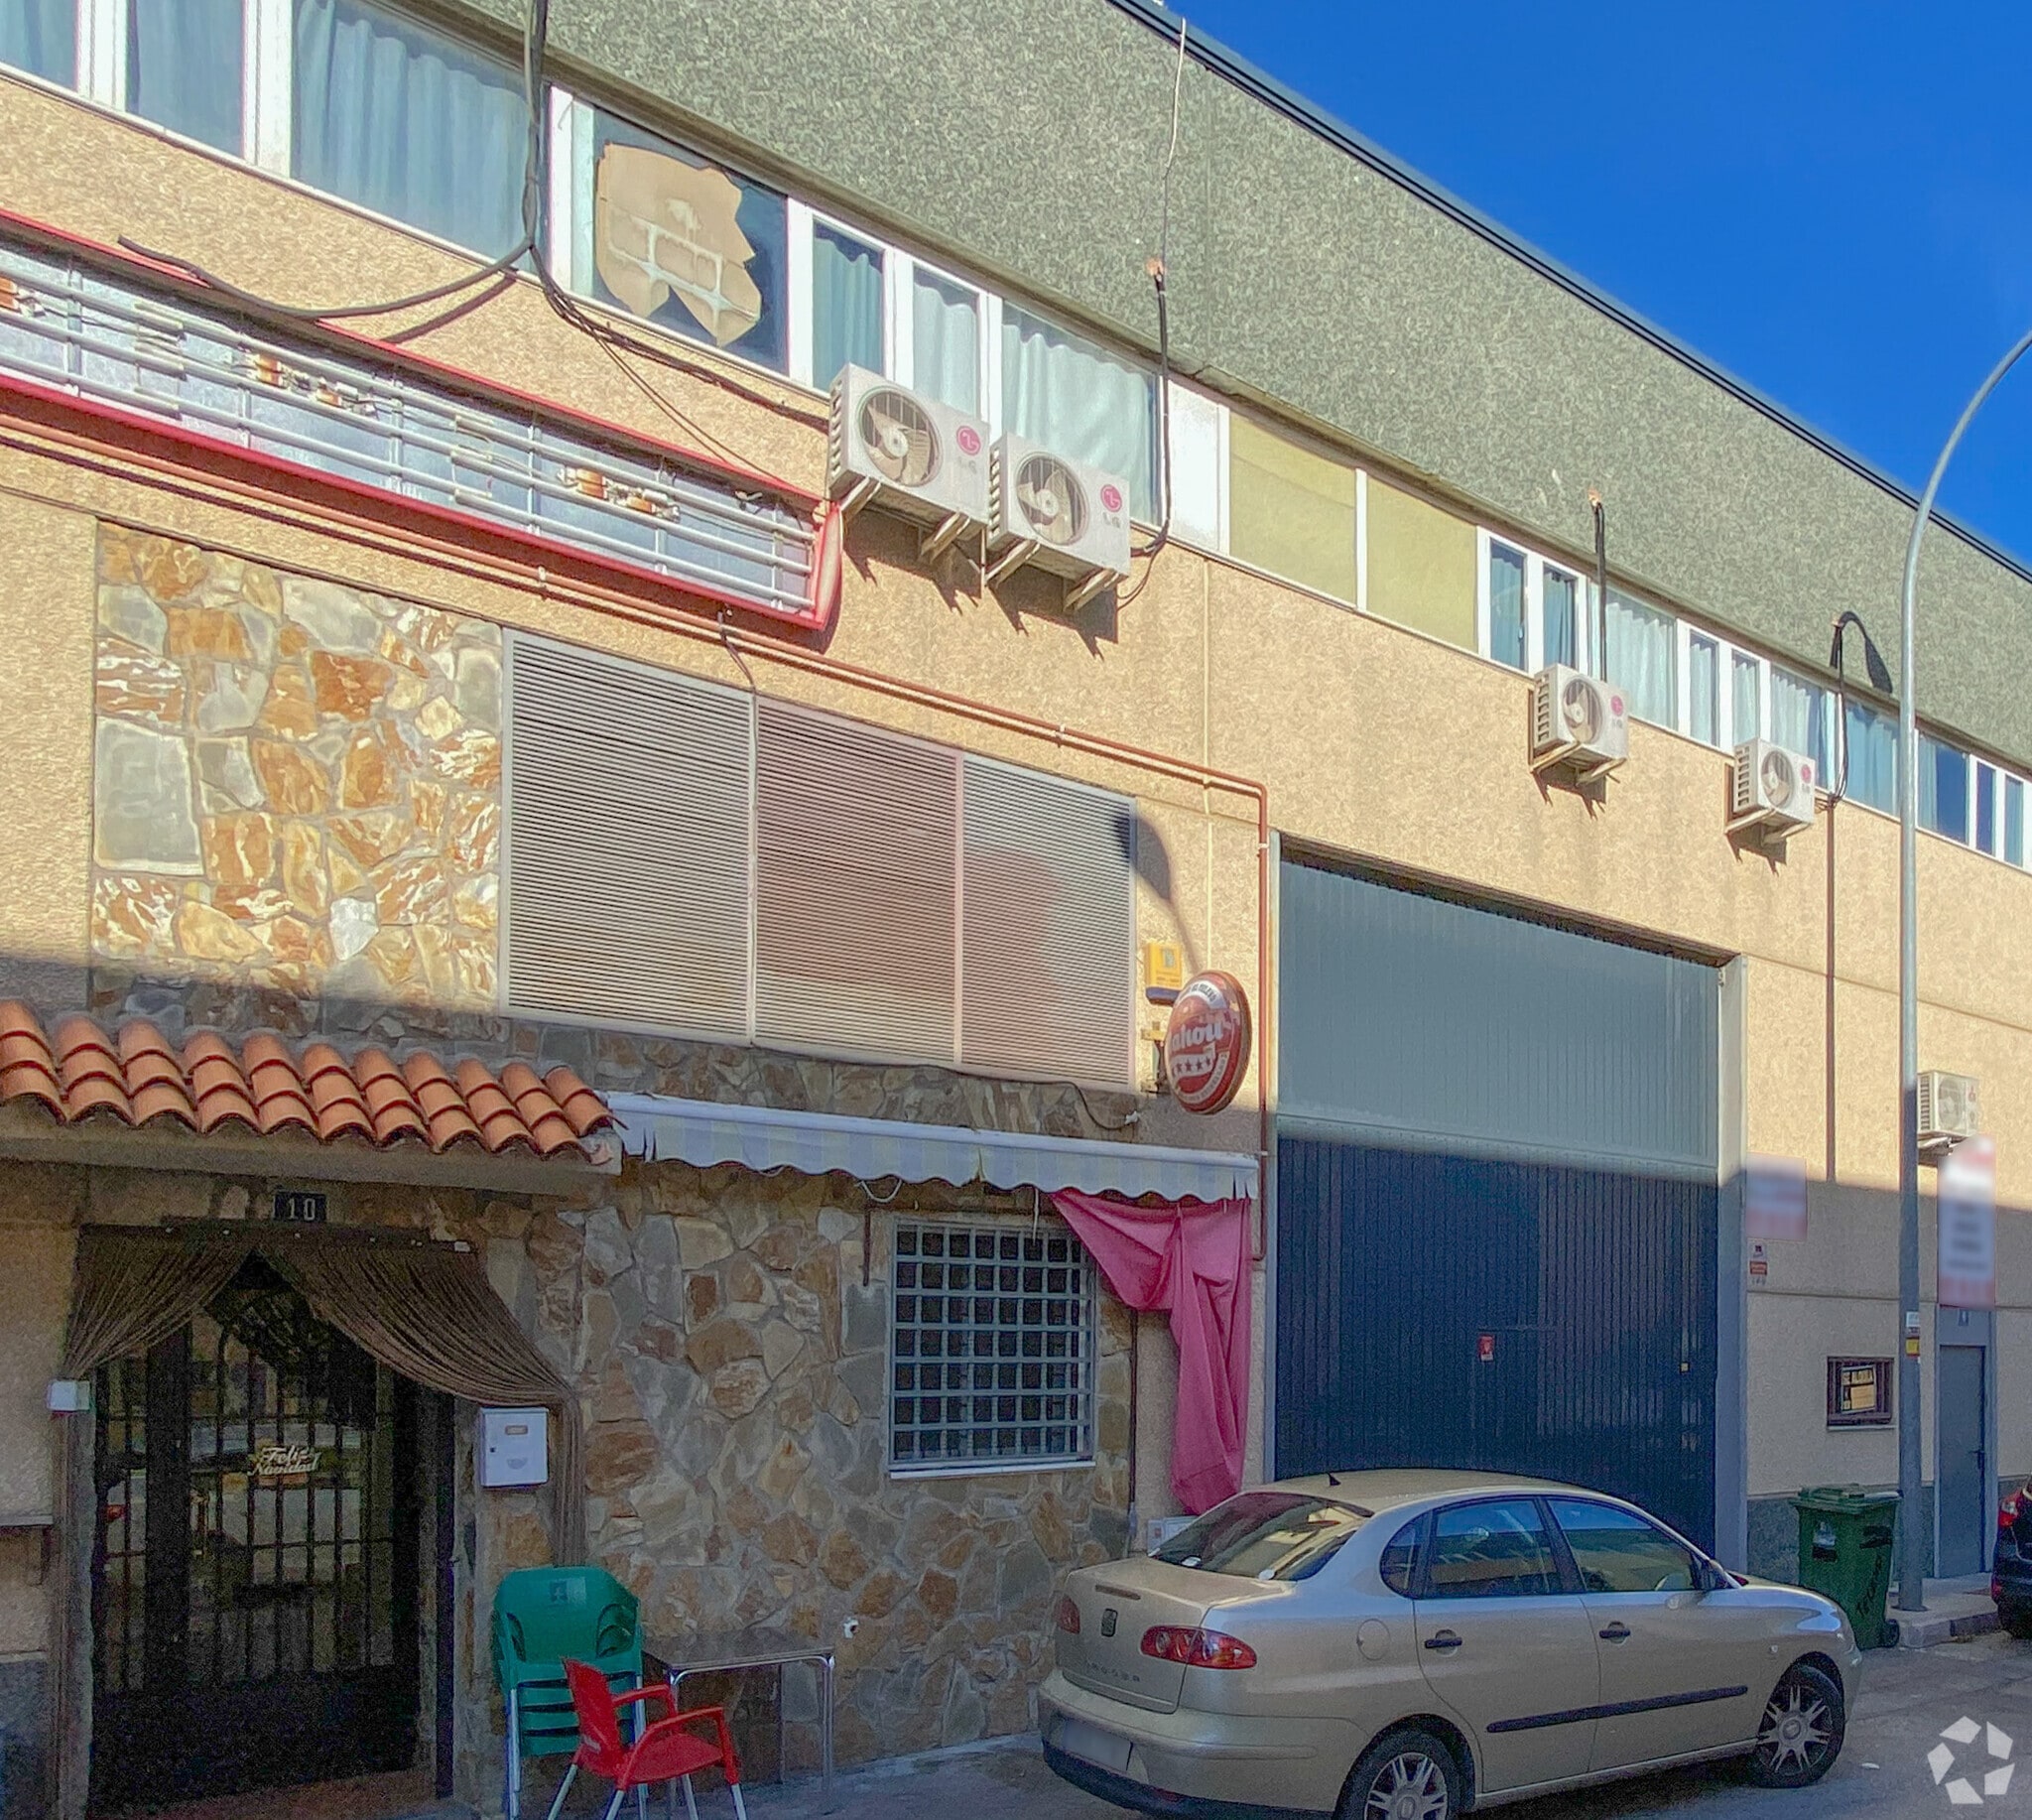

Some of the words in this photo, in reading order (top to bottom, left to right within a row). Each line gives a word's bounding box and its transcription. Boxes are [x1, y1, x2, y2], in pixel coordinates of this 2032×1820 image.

[287, 1196, 317, 1222] 10
[247, 1452, 322, 1477] Navidad
[261, 1445, 313, 1465] Feliz
